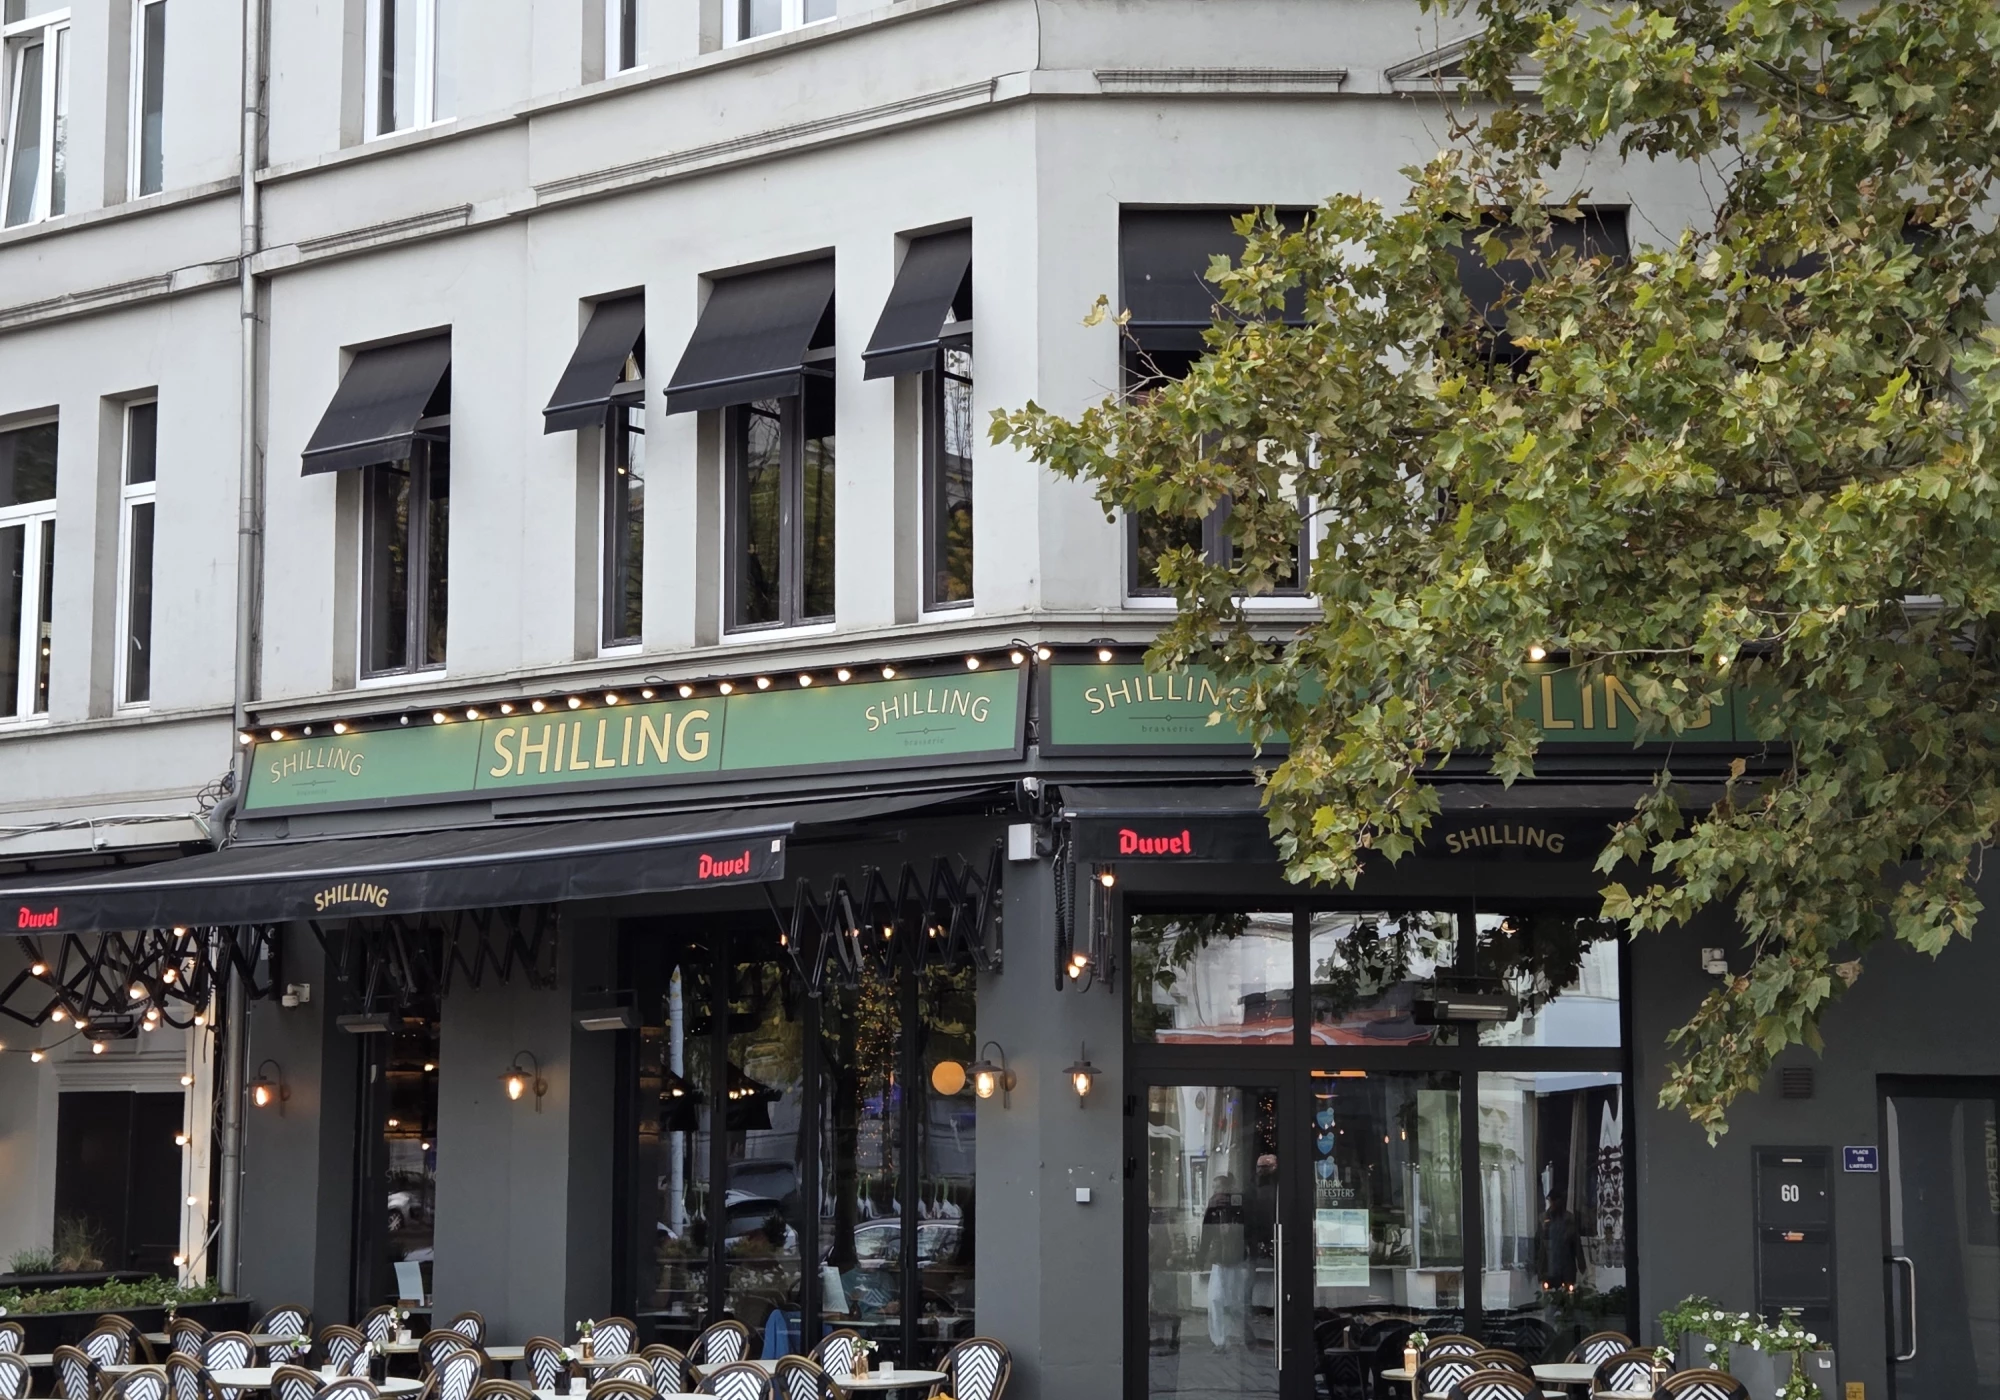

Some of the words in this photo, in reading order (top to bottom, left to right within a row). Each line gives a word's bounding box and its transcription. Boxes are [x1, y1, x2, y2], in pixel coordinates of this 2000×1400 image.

[864, 688, 991, 732] SHILLING
[1141, 724, 1195, 733] brasserie
[489, 709, 711, 778] SHILLING
[270, 747, 365, 784] SHILLING
[1119, 828, 1191, 854] Duvel
[1445, 824, 1565, 854] SHILLING
[699, 850, 750, 879] Duvel
[314, 882, 390, 912] SHILLING
[18, 906, 59, 928] Duvel
[1316, 1188, 1355, 1197] MEESTERS
[1781, 1184, 1800, 1202] 60
